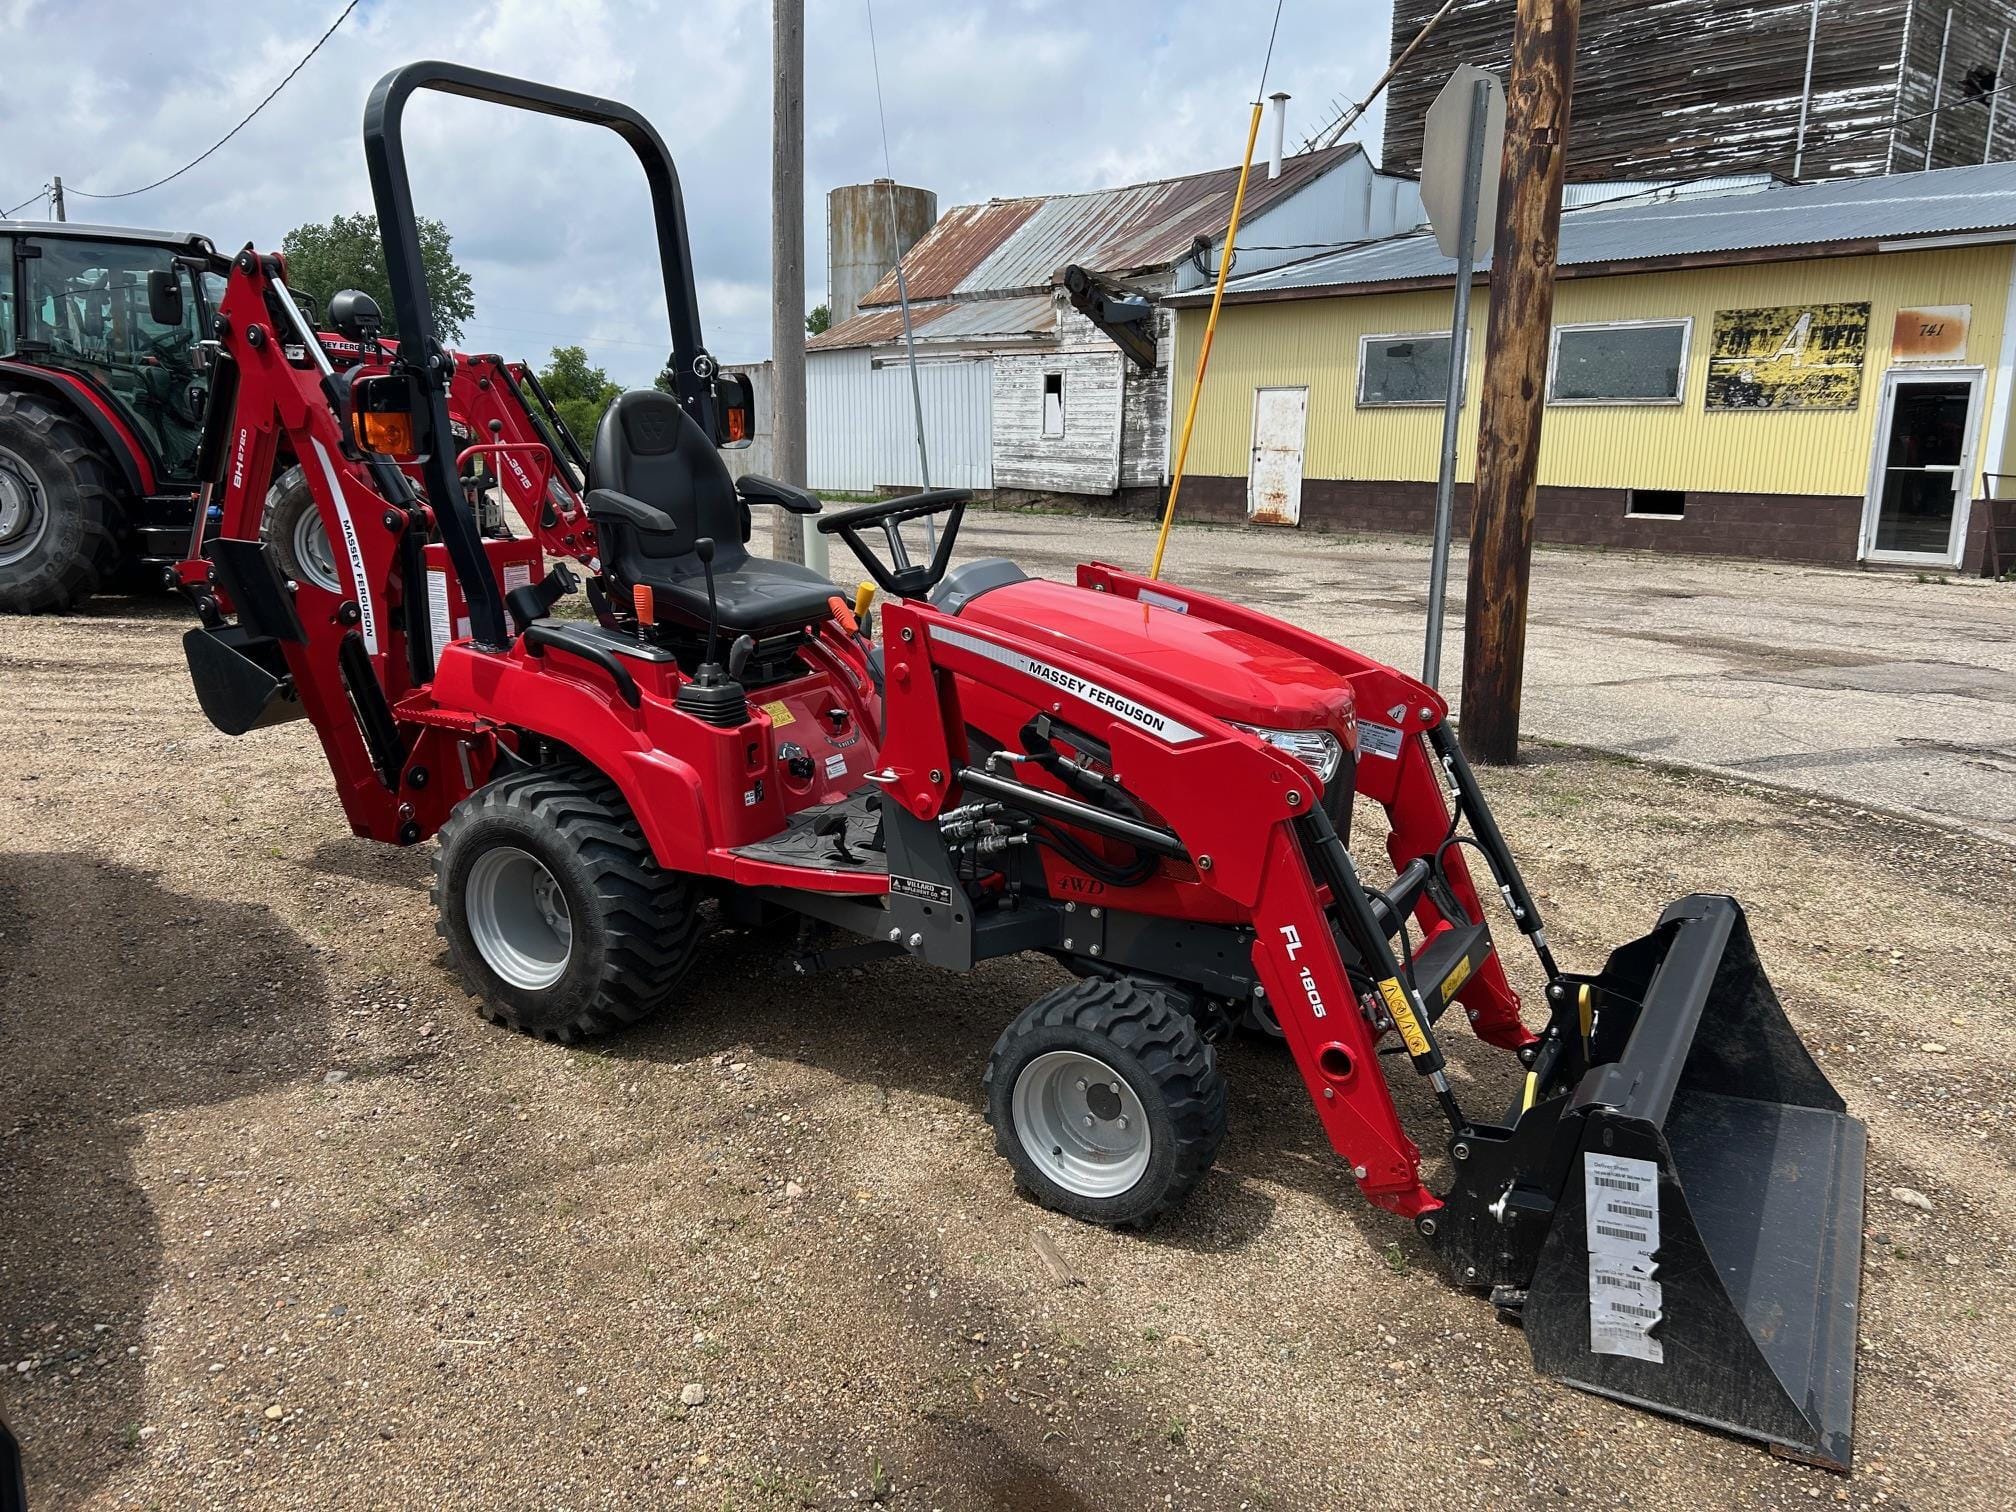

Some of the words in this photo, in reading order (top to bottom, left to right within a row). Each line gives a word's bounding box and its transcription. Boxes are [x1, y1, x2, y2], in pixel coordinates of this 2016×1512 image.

[1918, 323, 1945, 337] 741
[343, 519, 362, 569] MASSEY
[356, 573, 373, 637] FERGUSON
[1029, 661, 1086, 693] MASSEY
[1088, 687, 1165, 732] FERGUSON
[901, 885, 930, 896] PLEENT
[906, 880, 935, 892] VILLARD
[1057, 876, 1105, 895] 4WD
[1279, 925, 1303, 961] FL
[1299, 966, 1327, 1018] 1805
